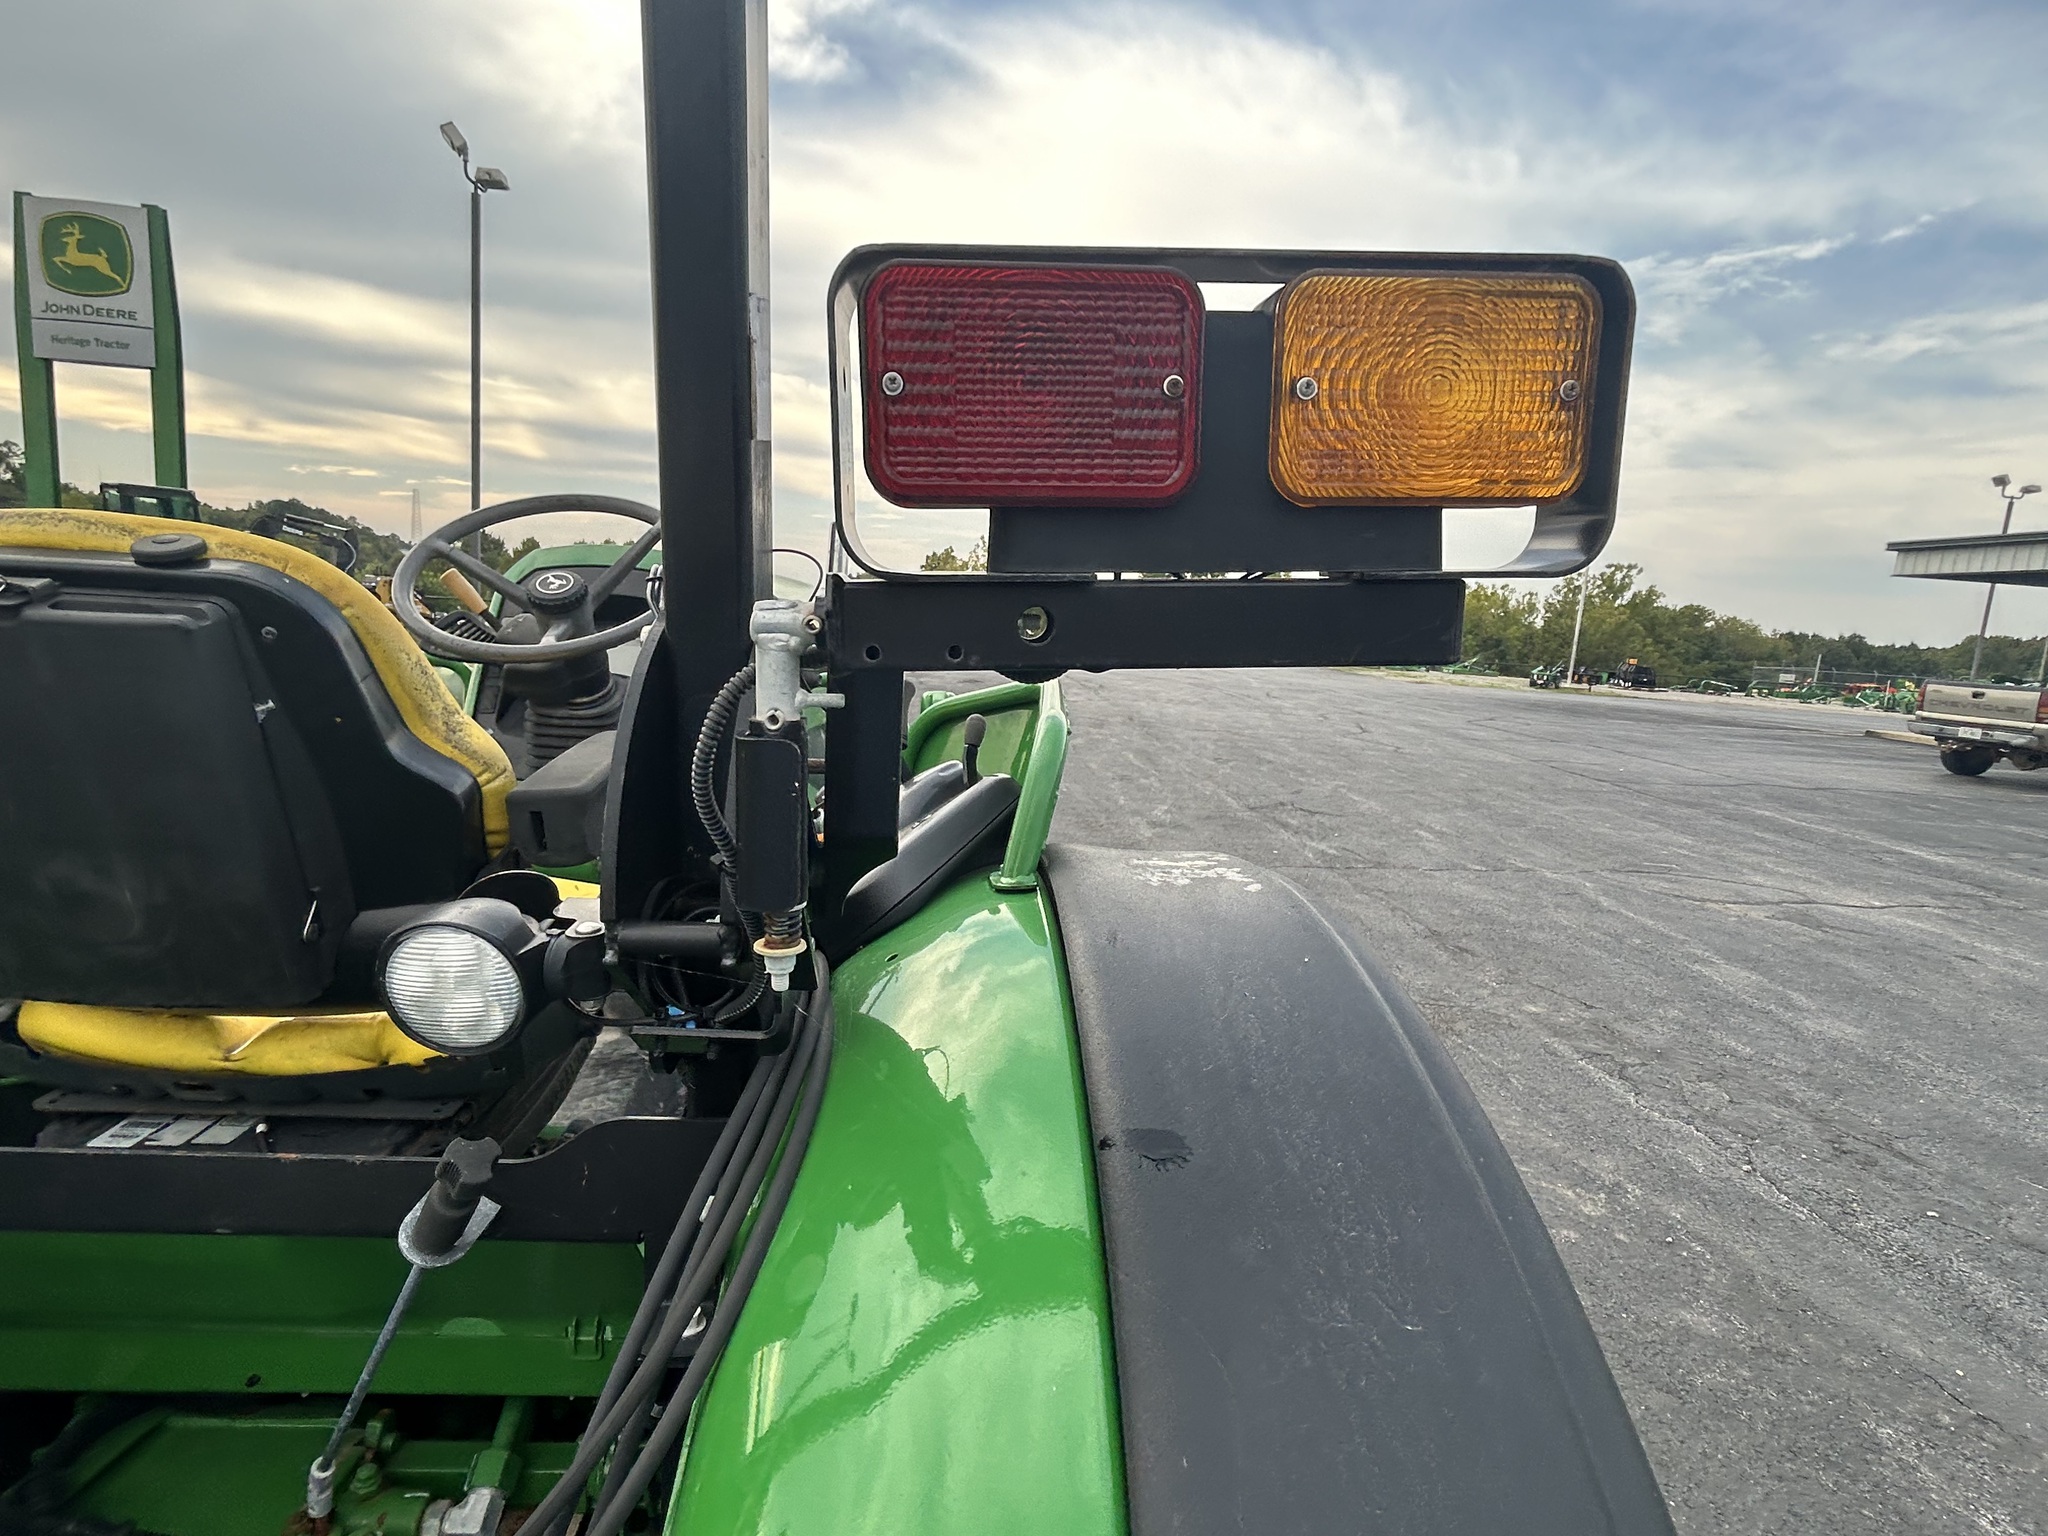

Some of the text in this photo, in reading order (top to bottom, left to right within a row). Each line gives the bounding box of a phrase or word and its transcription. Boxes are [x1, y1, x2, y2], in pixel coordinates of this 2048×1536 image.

[41, 301, 138, 321] JOHN DEERE
[50, 335, 130, 350] Heritage Tractor
[1929, 699, 2031, 714] CHEVROLET
